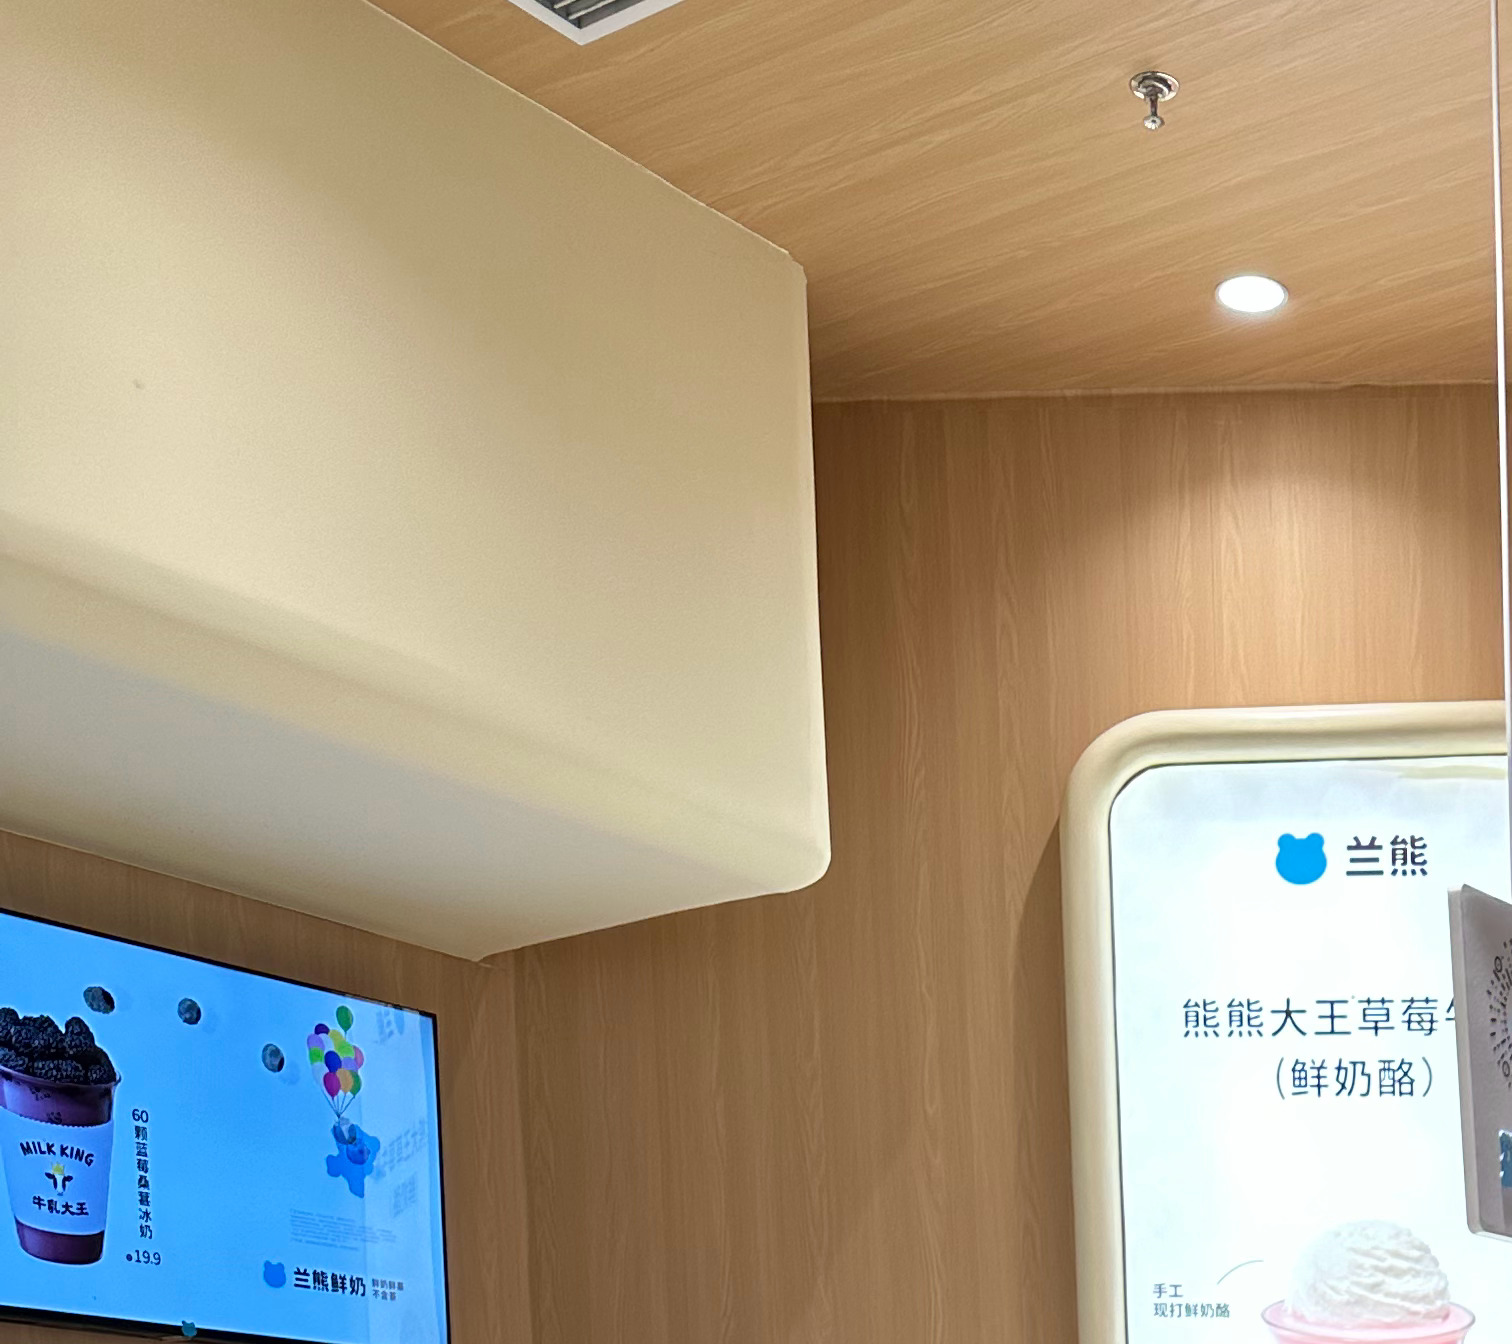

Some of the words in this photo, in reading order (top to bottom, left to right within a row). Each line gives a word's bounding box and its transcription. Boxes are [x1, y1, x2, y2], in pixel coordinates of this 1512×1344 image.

[1345, 834, 1429, 878] 兰熊
[1275, 1056, 1433, 1100] (鲜奶酪)
[20, 1141, 56, 1156] MILK
[60, 1144, 94, 1167] KING
[32, 1195, 90, 1217] 牛乳大王
[293, 1266, 366, 1297] 兰熊鲜奶
[1152, 1283, 1184, 1299] 手工
[1153, 1302, 1230, 1318] 现打鲜奶酪
